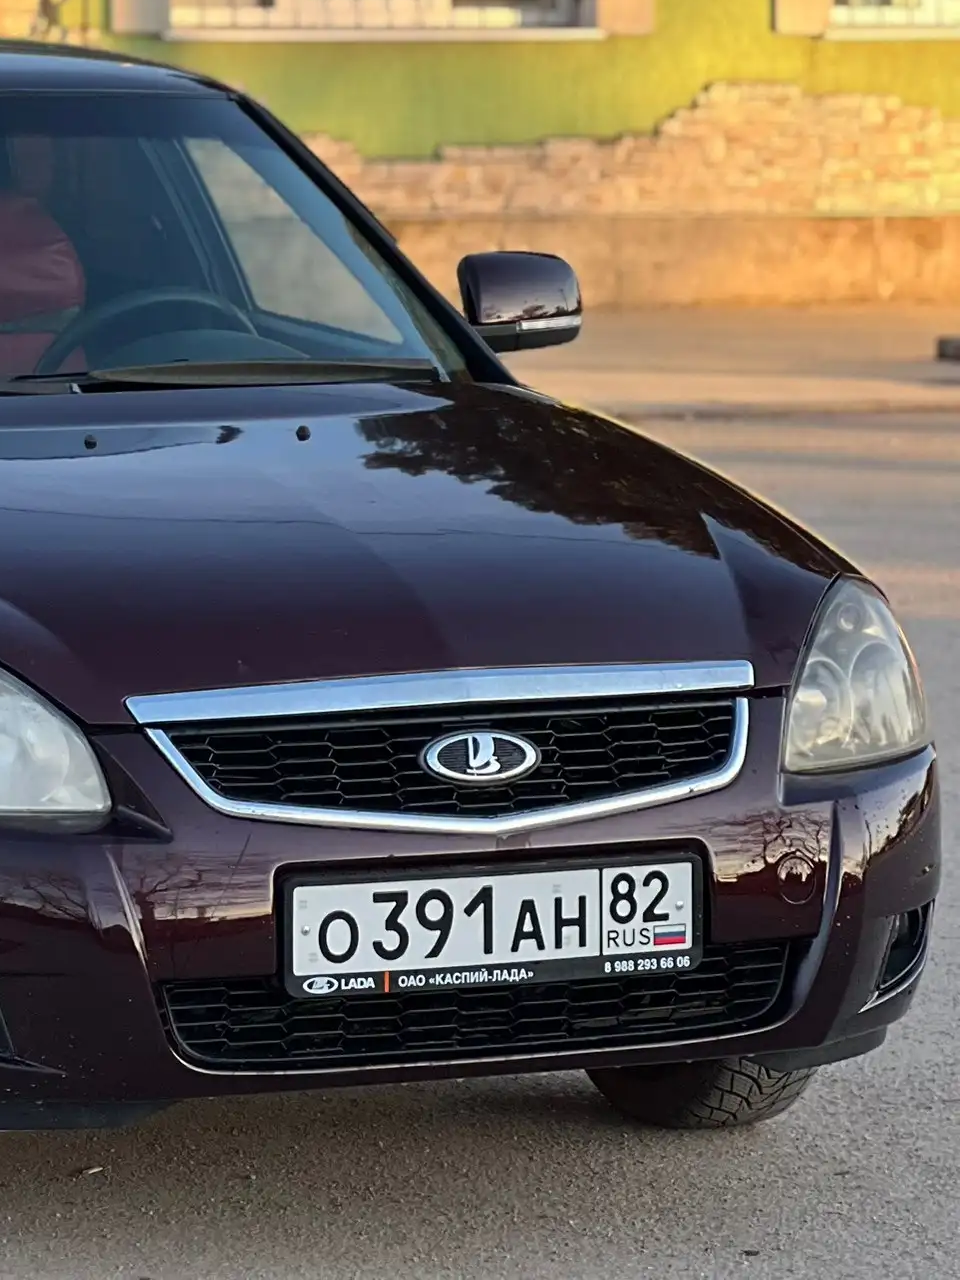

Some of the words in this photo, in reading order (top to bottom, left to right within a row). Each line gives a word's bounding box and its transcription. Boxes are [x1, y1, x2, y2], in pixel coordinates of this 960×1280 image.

[609, 869, 670, 924] 82
[318, 884, 587, 964] О391АН
[607, 927, 651, 949] RUS
[603, 961, 612, 973] 8
[614, 959, 635, 973] 988
[637, 958, 658, 971] 293
[659, 957, 675, 969] 66
[676, 955, 691, 968] 06
[340, 976, 376, 990] LADA
[397, 973, 427, 988] ОАО
[428, 967, 534, 986] «КАСПИЙ-ЛАДА»
